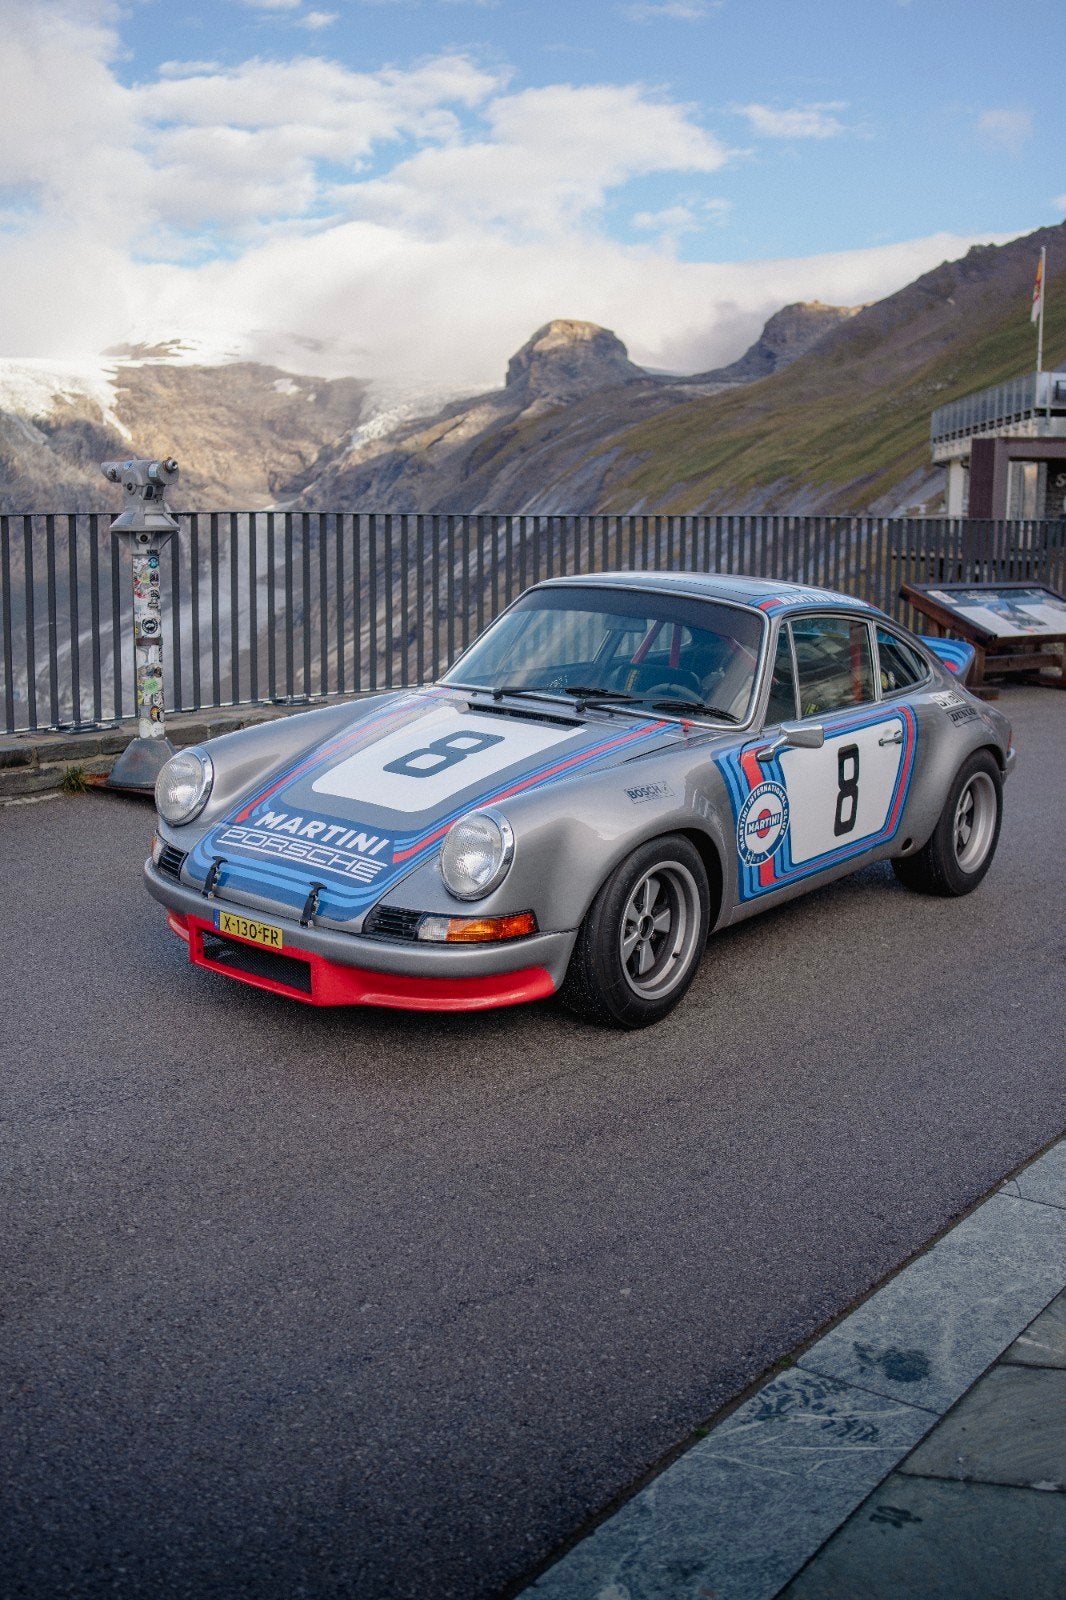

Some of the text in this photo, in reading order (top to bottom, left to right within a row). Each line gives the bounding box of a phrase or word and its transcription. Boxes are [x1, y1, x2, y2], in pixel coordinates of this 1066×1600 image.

[931, 690, 966, 707] Shell
[383, 730, 505, 778] 8
[626, 785, 662, 799] BOSCH
[747, 784, 786, 807] INTERNATIONAL
[833, 743, 860, 837] 8
[254, 811, 390, 856] MARTINI
[747, 813, 781, 833] MARTINI
[219, 827, 385, 881] PORSCHE
[224, 915, 279, 946] X-130-FR
